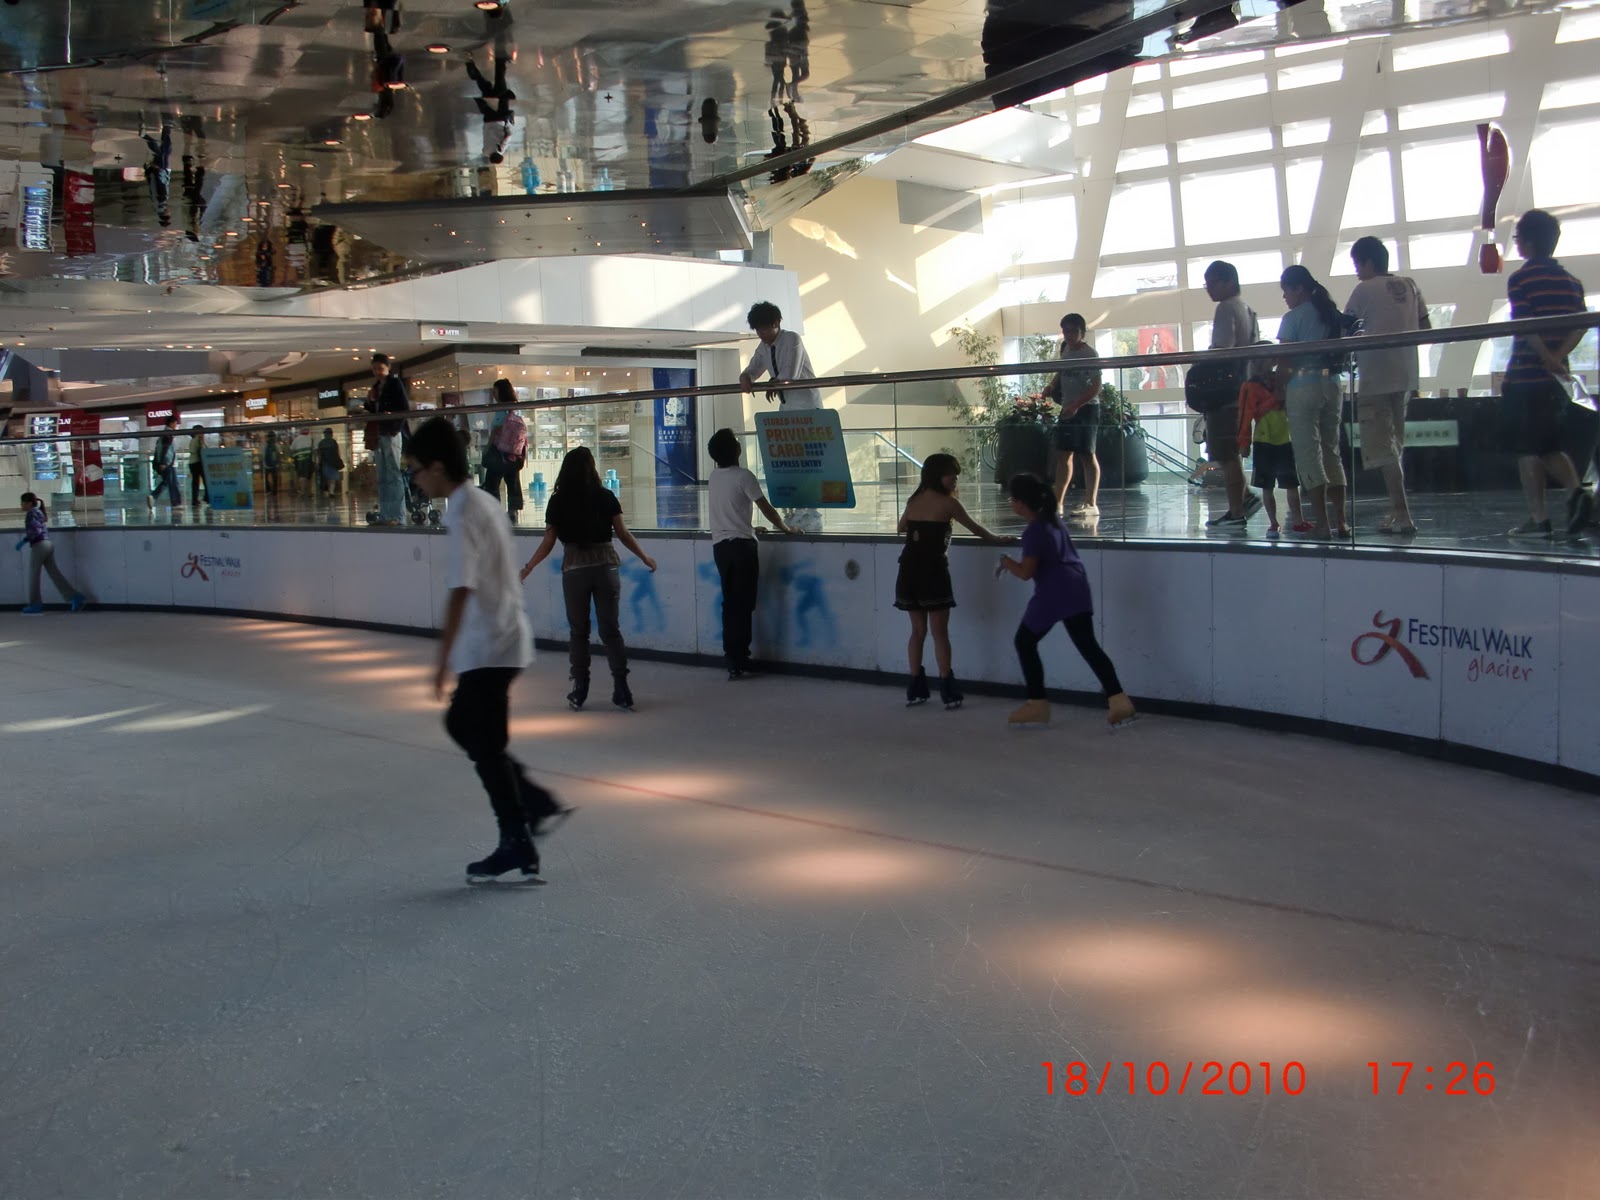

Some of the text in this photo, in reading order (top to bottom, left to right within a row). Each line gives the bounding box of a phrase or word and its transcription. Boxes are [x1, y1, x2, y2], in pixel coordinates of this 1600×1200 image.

[148, 409, 173, 418] CLARINS
[765, 426, 834, 442] PRIVILEGE
[768, 443, 805, 458] CARD
[771, 459, 822, 468] EXPRESS ENTRY
[1482, 626, 1533, 660] WALK
[1467, 653, 1534, 682] glacier
